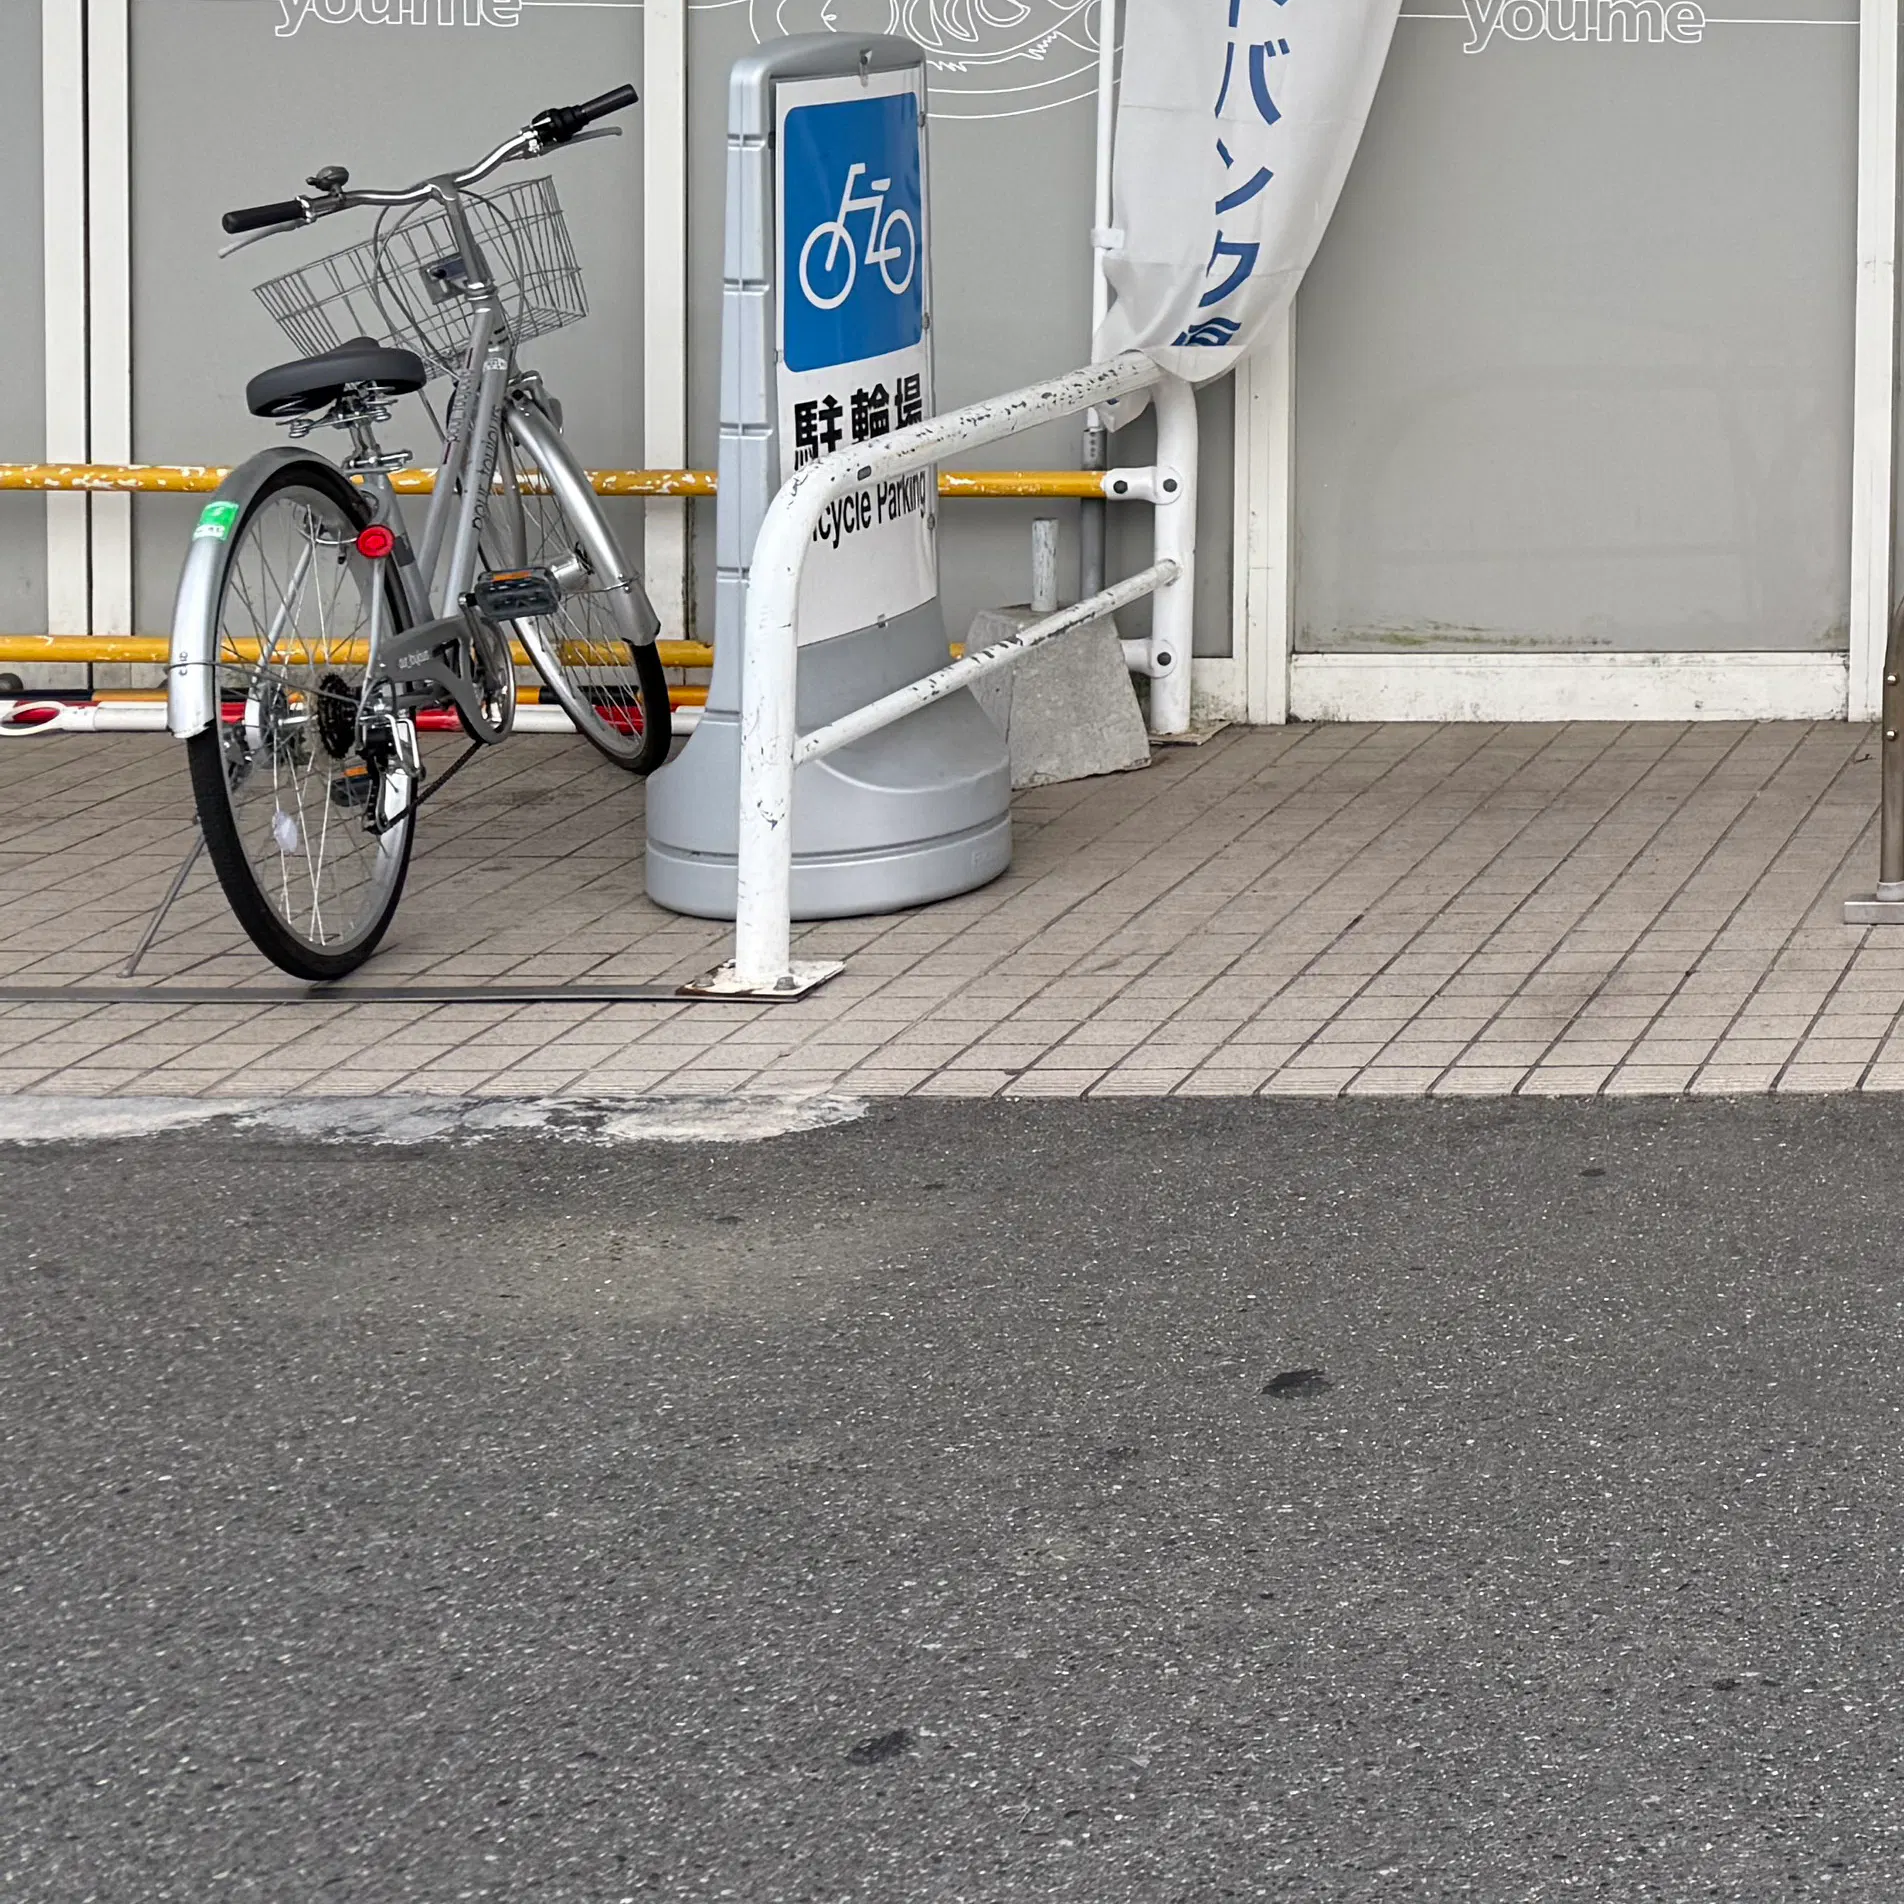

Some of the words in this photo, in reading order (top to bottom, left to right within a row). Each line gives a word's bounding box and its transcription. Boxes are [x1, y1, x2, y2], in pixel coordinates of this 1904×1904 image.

[794, 373, 922, 471] 駐輪場
[813, 491, 871, 549] cycle
[877, 470, 926, 523] Parking
